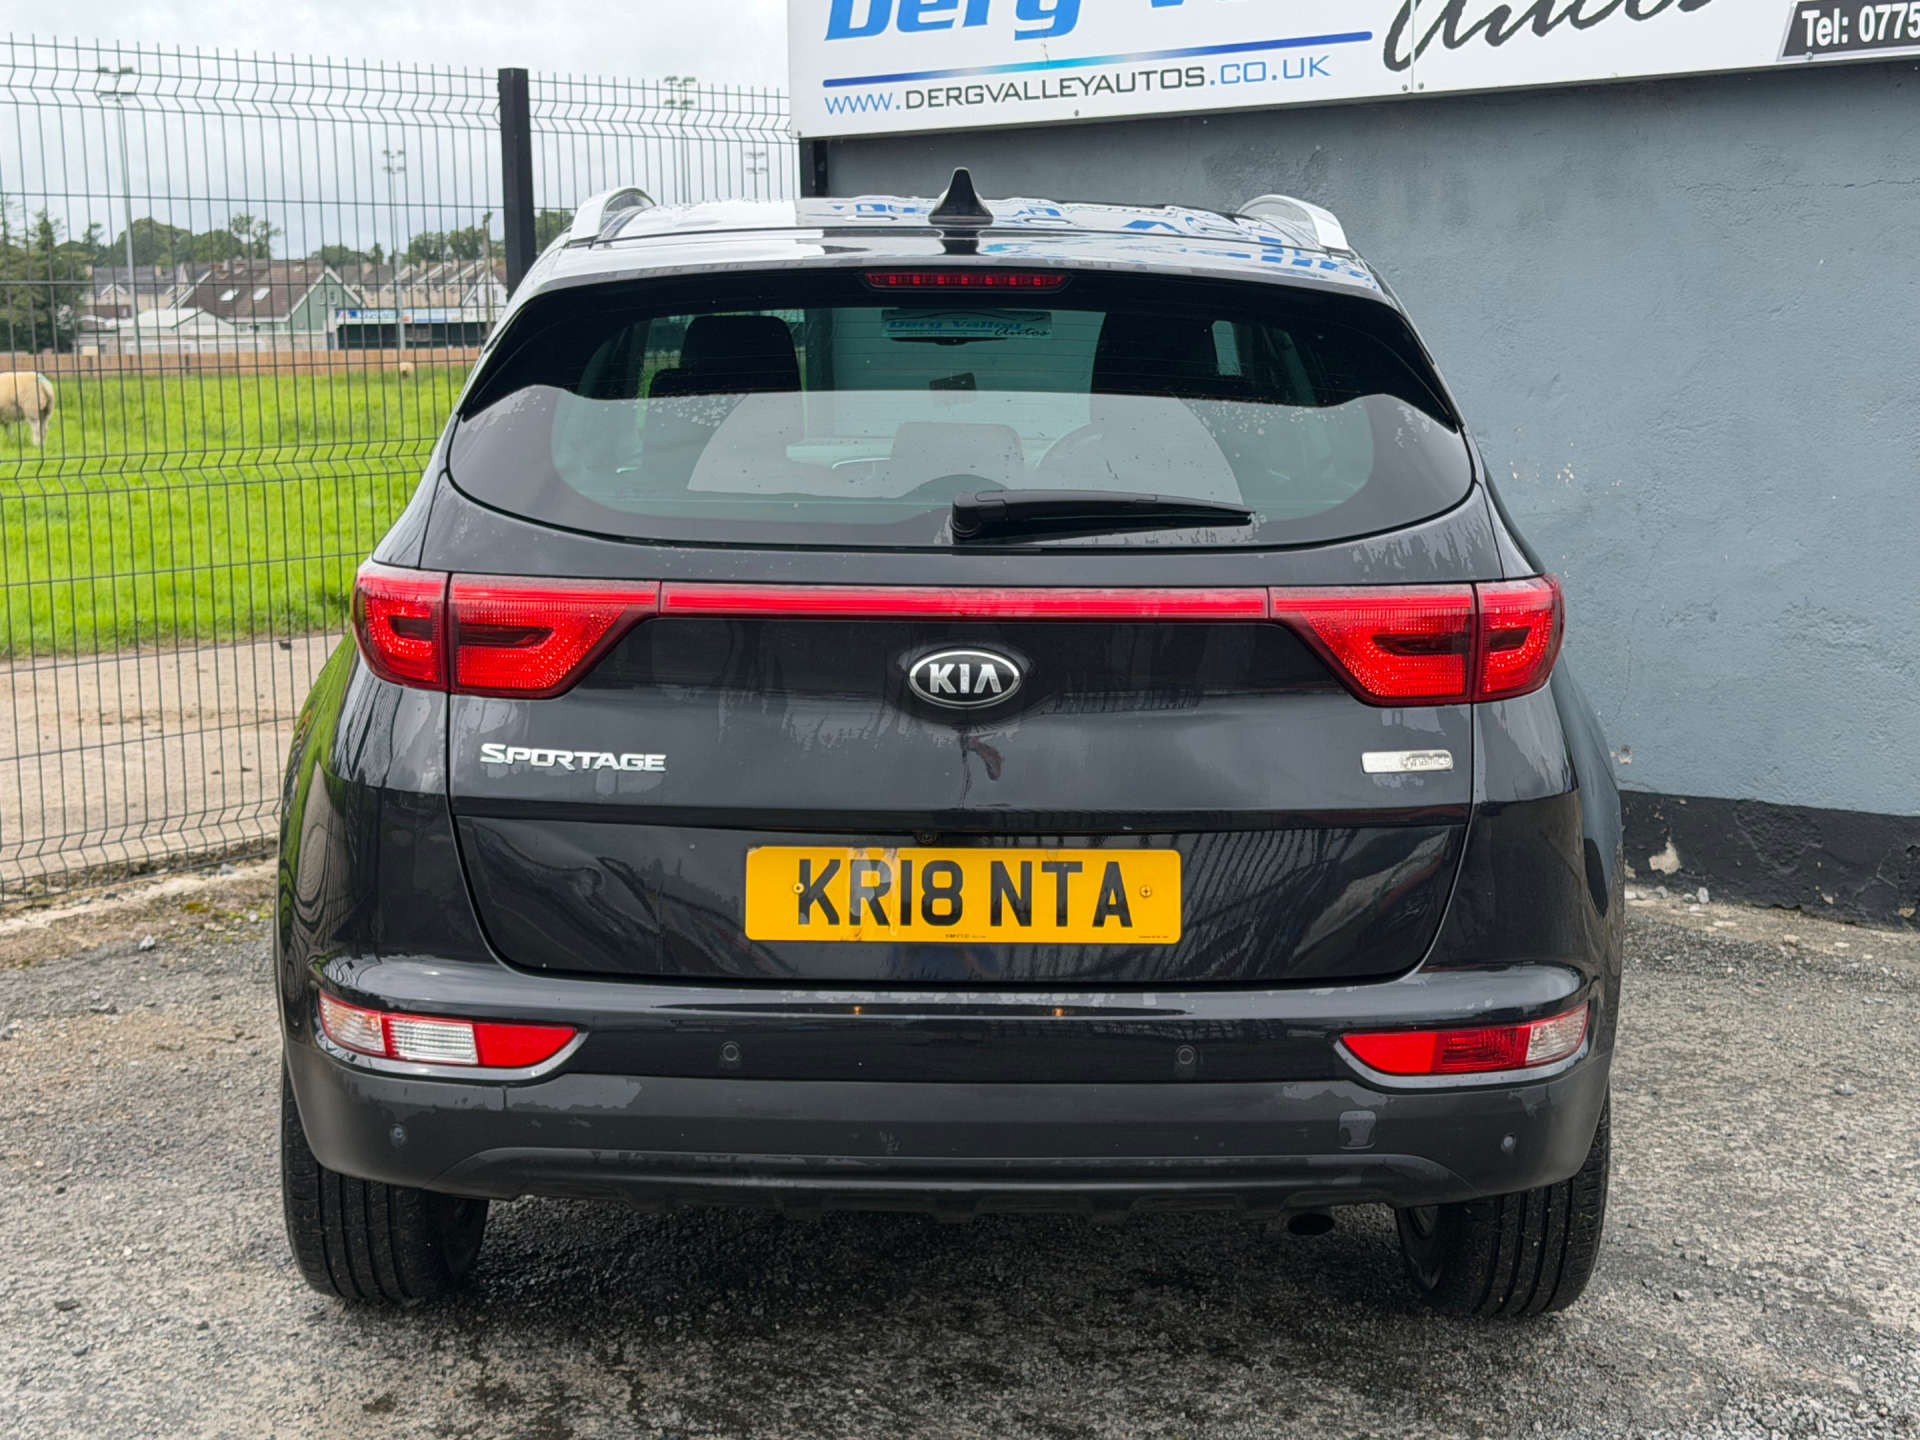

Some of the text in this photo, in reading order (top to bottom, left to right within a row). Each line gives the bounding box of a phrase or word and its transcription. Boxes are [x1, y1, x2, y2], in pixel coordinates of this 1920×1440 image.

[1801, 1, 1920, 47] Tel: 0775
[929, 664, 1002, 693] KIA
[798, 858, 1134, 928] KR18 NTA
